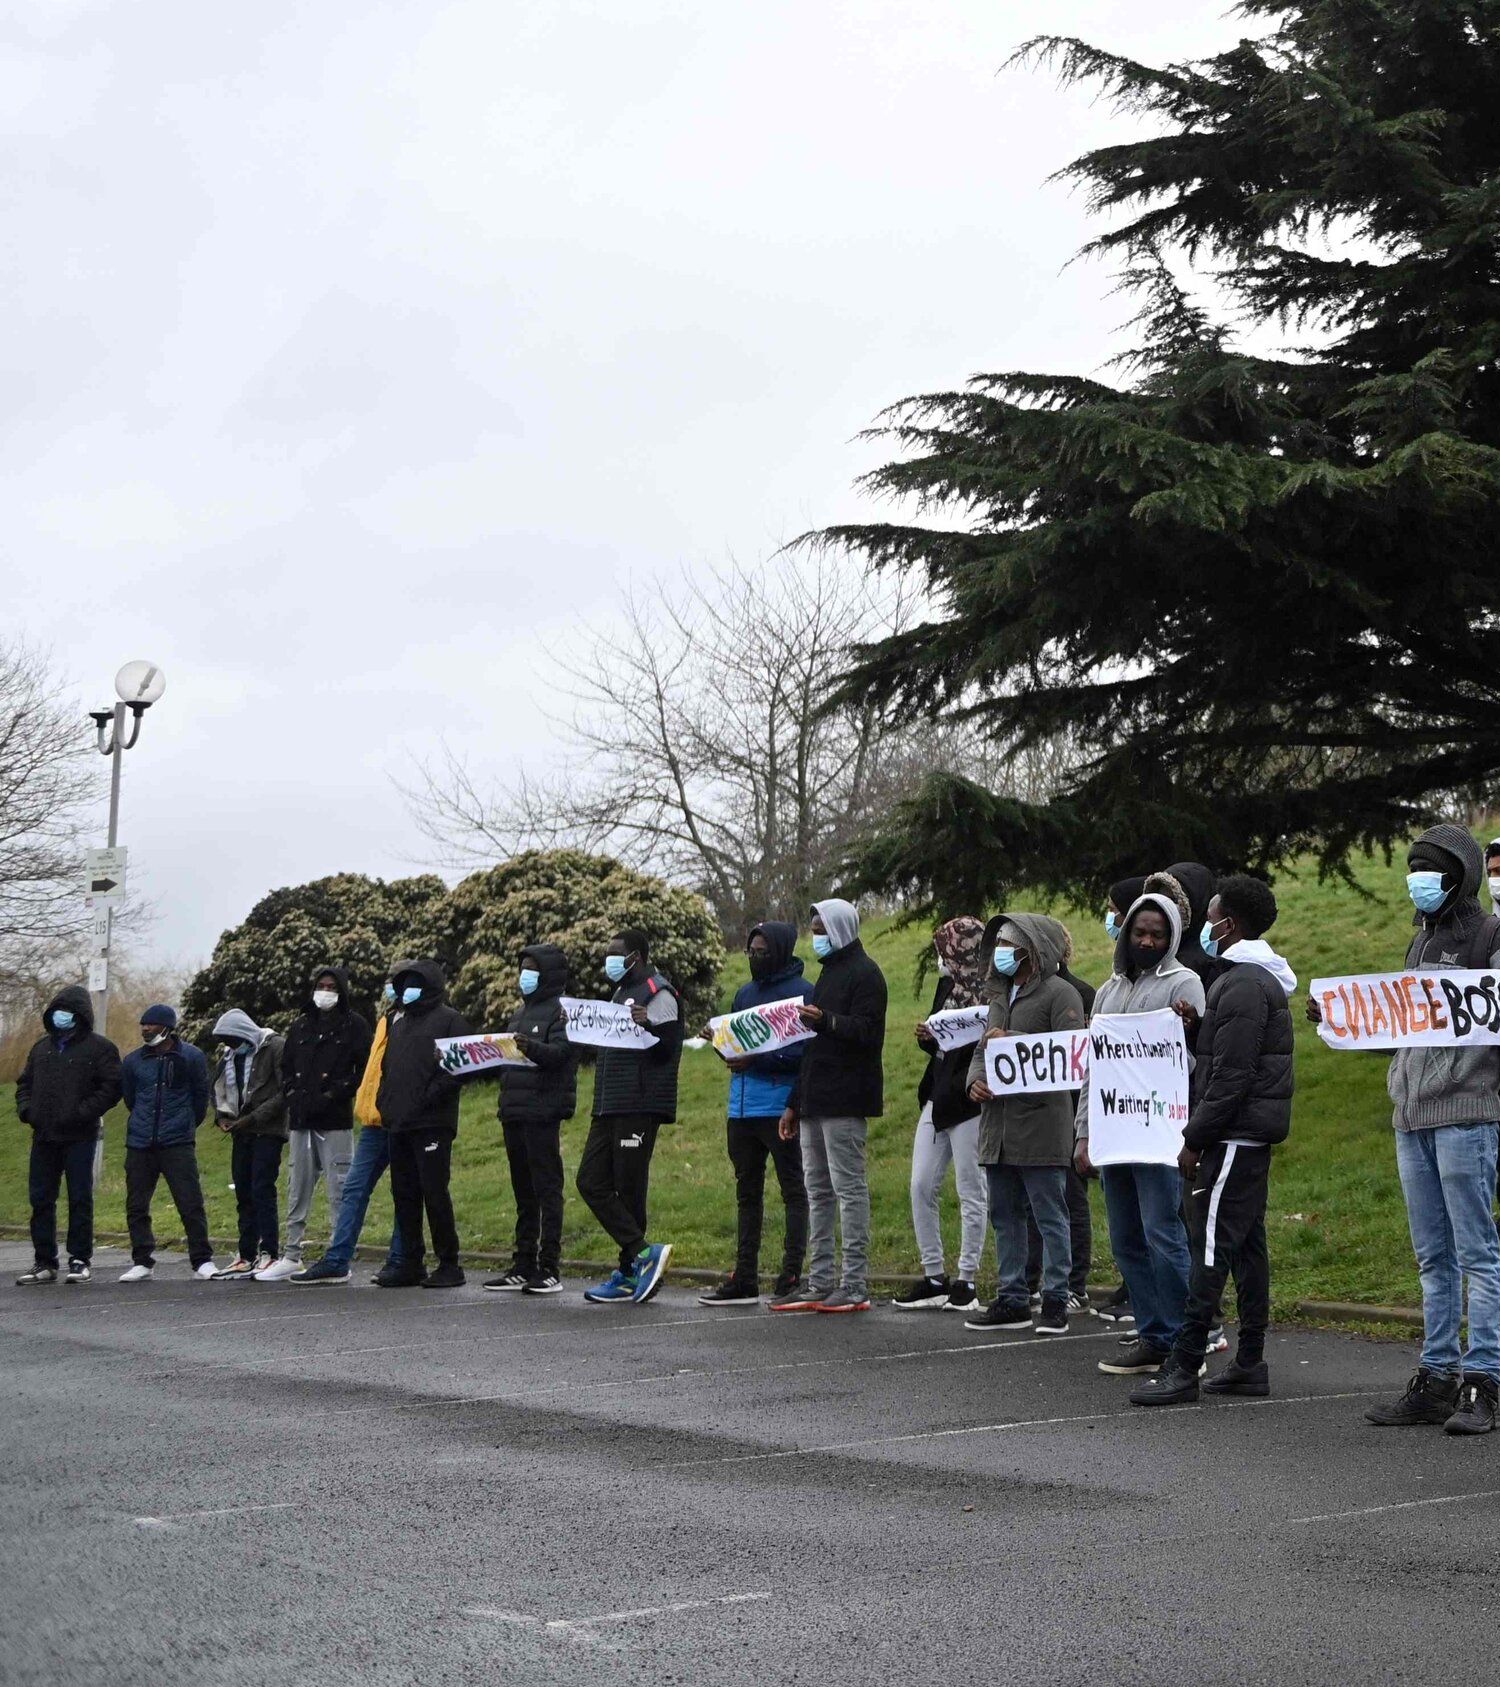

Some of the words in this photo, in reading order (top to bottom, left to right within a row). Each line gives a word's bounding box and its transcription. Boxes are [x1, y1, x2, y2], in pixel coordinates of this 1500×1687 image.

[730, 1011, 771, 1052] NEED
[1091, 1033, 1134, 1060] Where
[1132, 1037, 1142, 1058] is
[1100, 1088, 1150, 1127] Waiting
